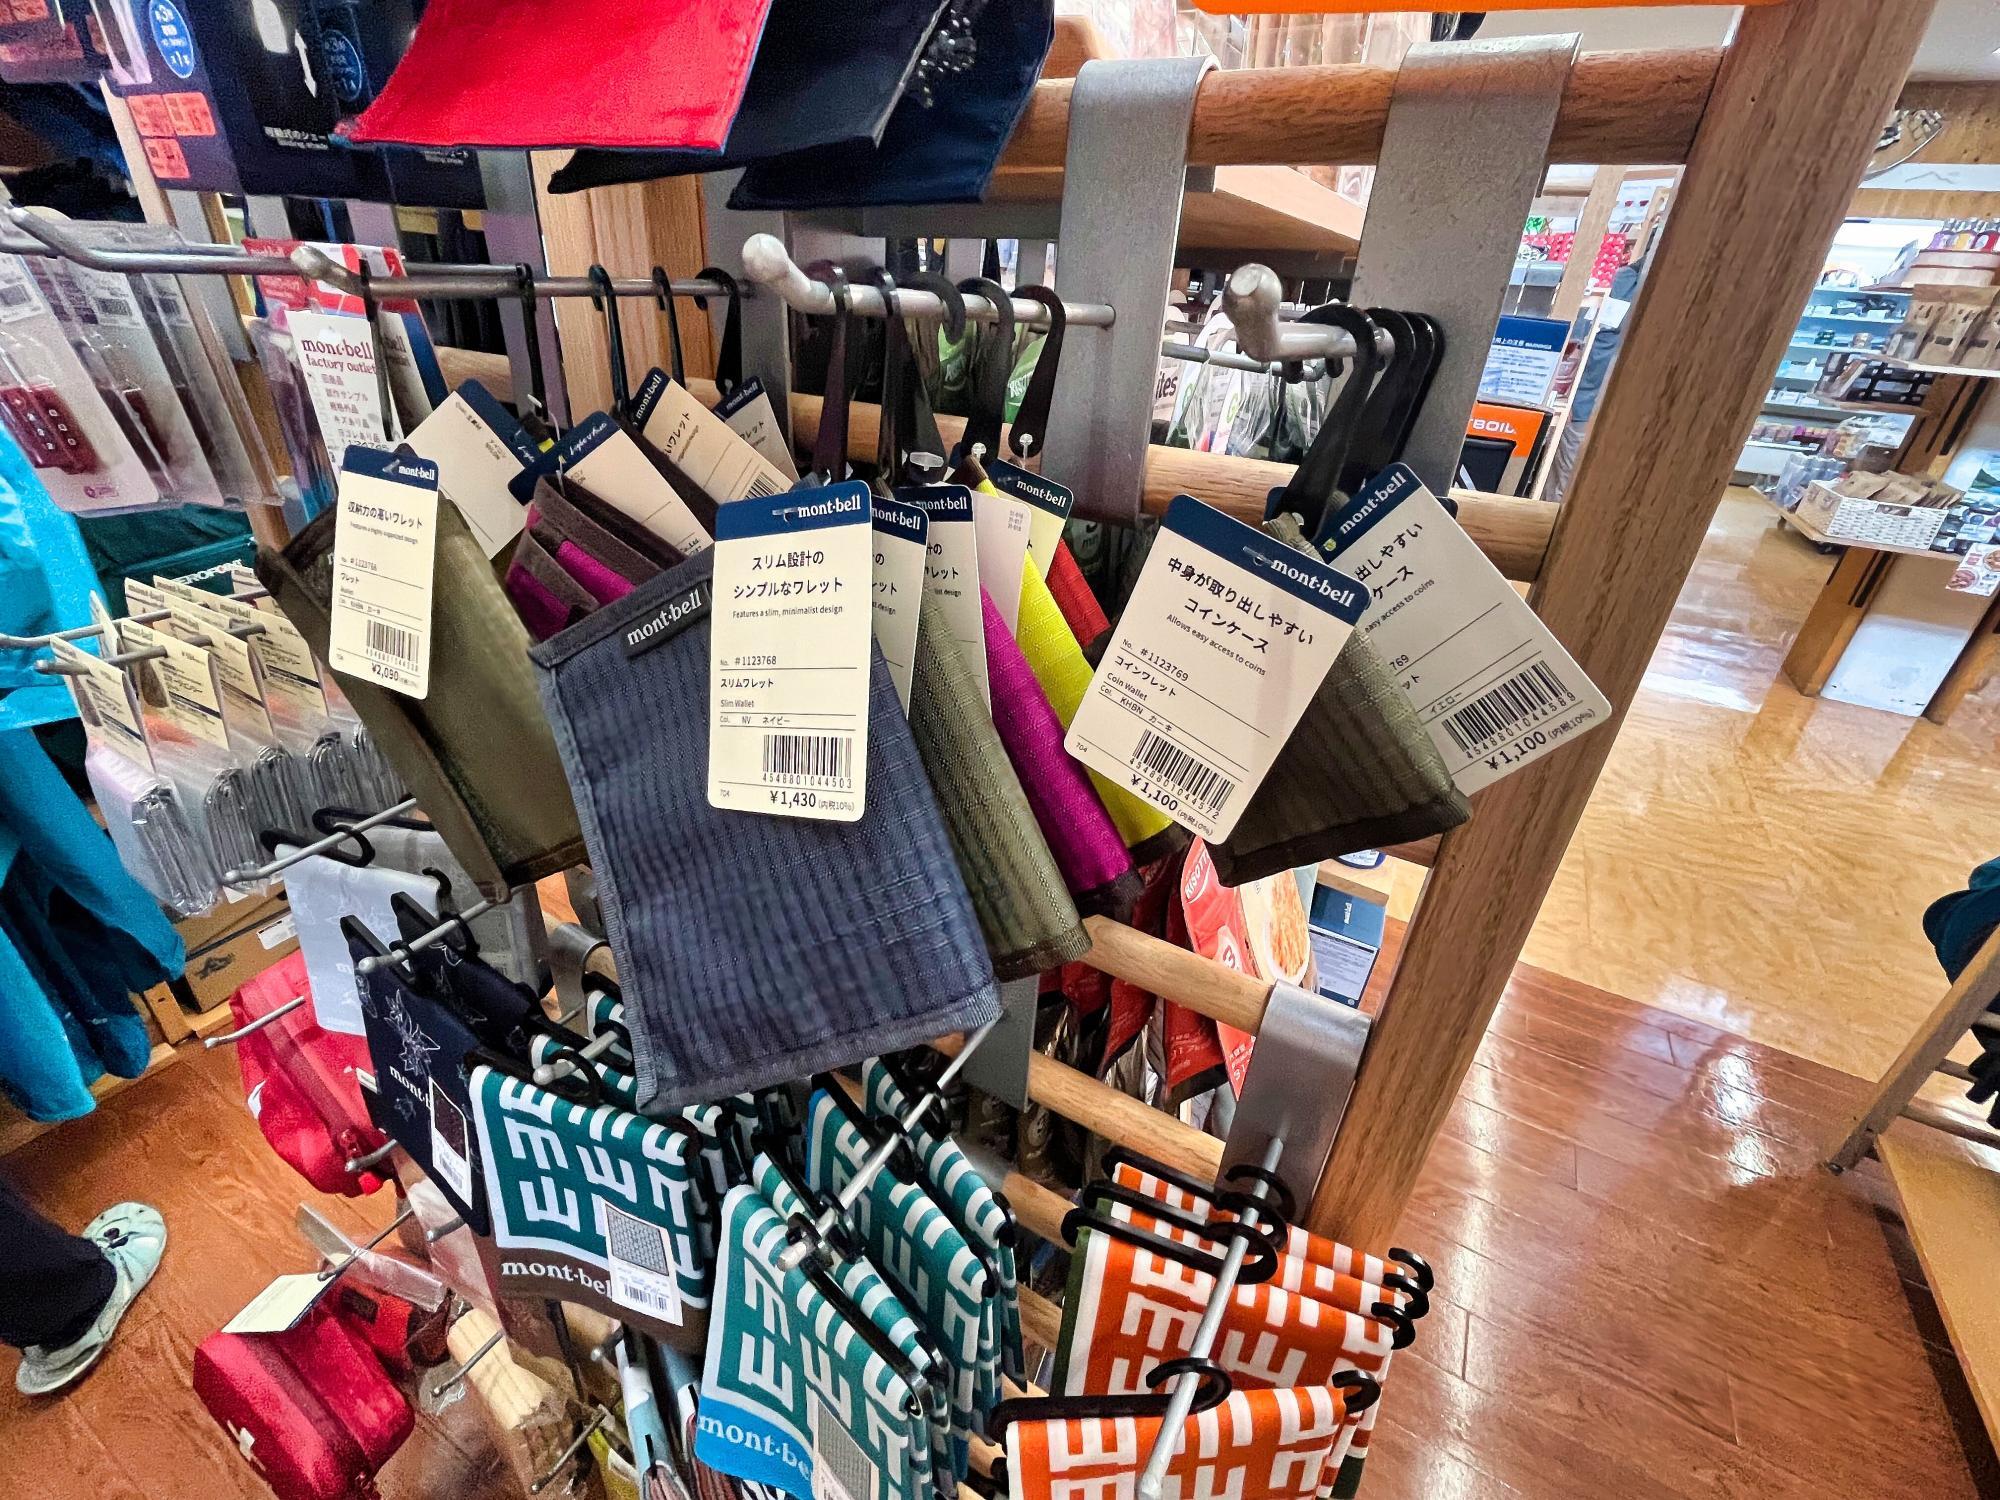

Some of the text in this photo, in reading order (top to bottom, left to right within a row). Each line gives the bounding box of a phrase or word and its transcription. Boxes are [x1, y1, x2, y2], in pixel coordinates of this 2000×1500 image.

[306, 354, 344, 372] factory
[752, 550, 824, 571] スリム設計の
[1354, 523, 1423, 582] 出しやすい
[733, 577, 843, 600] シンプルなワレット
[944, 589, 962, 598] design
[1373, 565, 1414, 600] ケース
[733, 608, 759, 619] Features
[765, 608, 781, 618] slim,
[782, 606, 818, 615] minimalist
[820, 605, 843, 615] design
[1167, 556, 1314, 646] 中身が取り出しやすい
[1364, 579, 1435, 634] easy access to coins
[1184, 597, 1270, 654] コインケース
[1166, 614, 1266, 676] Allows easy access to coins
[372, 662, 399, 681] ¥2,090
[735, 655, 777, 666] #1123768
[1122, 638, 1189, 682] No. #1123769
[1389, 654, 1410, 671] 769
[721, 678, 774, 689] スリムワレット
[1107, 672, 1148, 701] Coin Wallet
[1114, 655, 1177, 697] コインワレット
[721, 700, 755, 708] Slim Wallet
[1100, 685, 1173, 733] Col. KHBN カーキ
[1429, 692, 1463, 715] イエロー
[742, 716, 752, 724] NV
[762, 716, 791, 726] ネイビー
[1484, 730, 1548, 771] ¥1,100
[1076, 742, 1088, 754] 704
[1130, 774, 1179, 812] ¥1,100
[770, 790, 816, 809] ¥1,430
